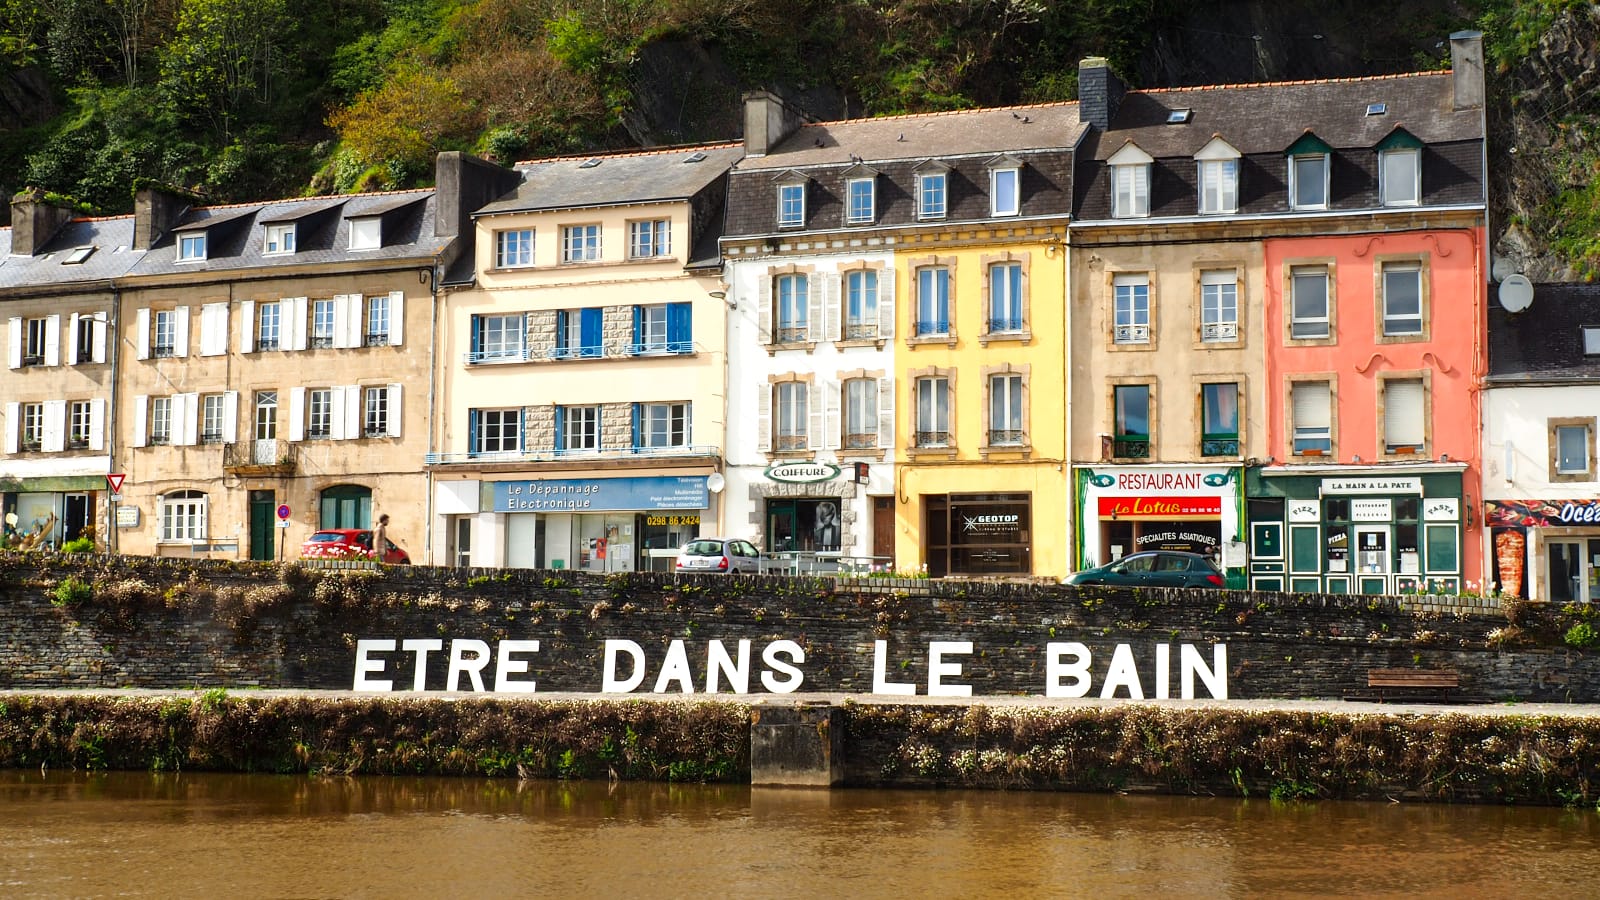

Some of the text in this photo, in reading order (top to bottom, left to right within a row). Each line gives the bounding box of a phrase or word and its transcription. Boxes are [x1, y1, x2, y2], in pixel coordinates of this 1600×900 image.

[773, 467, 826, 477] COIFFURE
[1119, 473, 1202, 490] RESTAURANT
[508, 482, 599, 497] Le Dépannage
[508, 498, 591, 511] Electronique
[1115, 498, 1180, 515] Le Lotus
[1293, 506, 1317, 516] PIZZA
[1428, 504, 1454, 515] PASTA
[1561, 501, 1600, 522] Océa
[647, 516, 700, 526] 0298 86 2424
[978, 515, 1018, 523] GEOTOP
[1136, 532, 1216, 546] SPECIALITES ASIATIQUES
[1327, 532, 1347, 545] PIZZA
[353, 639, 1228, 700] ETRE DANS LE BAIN
